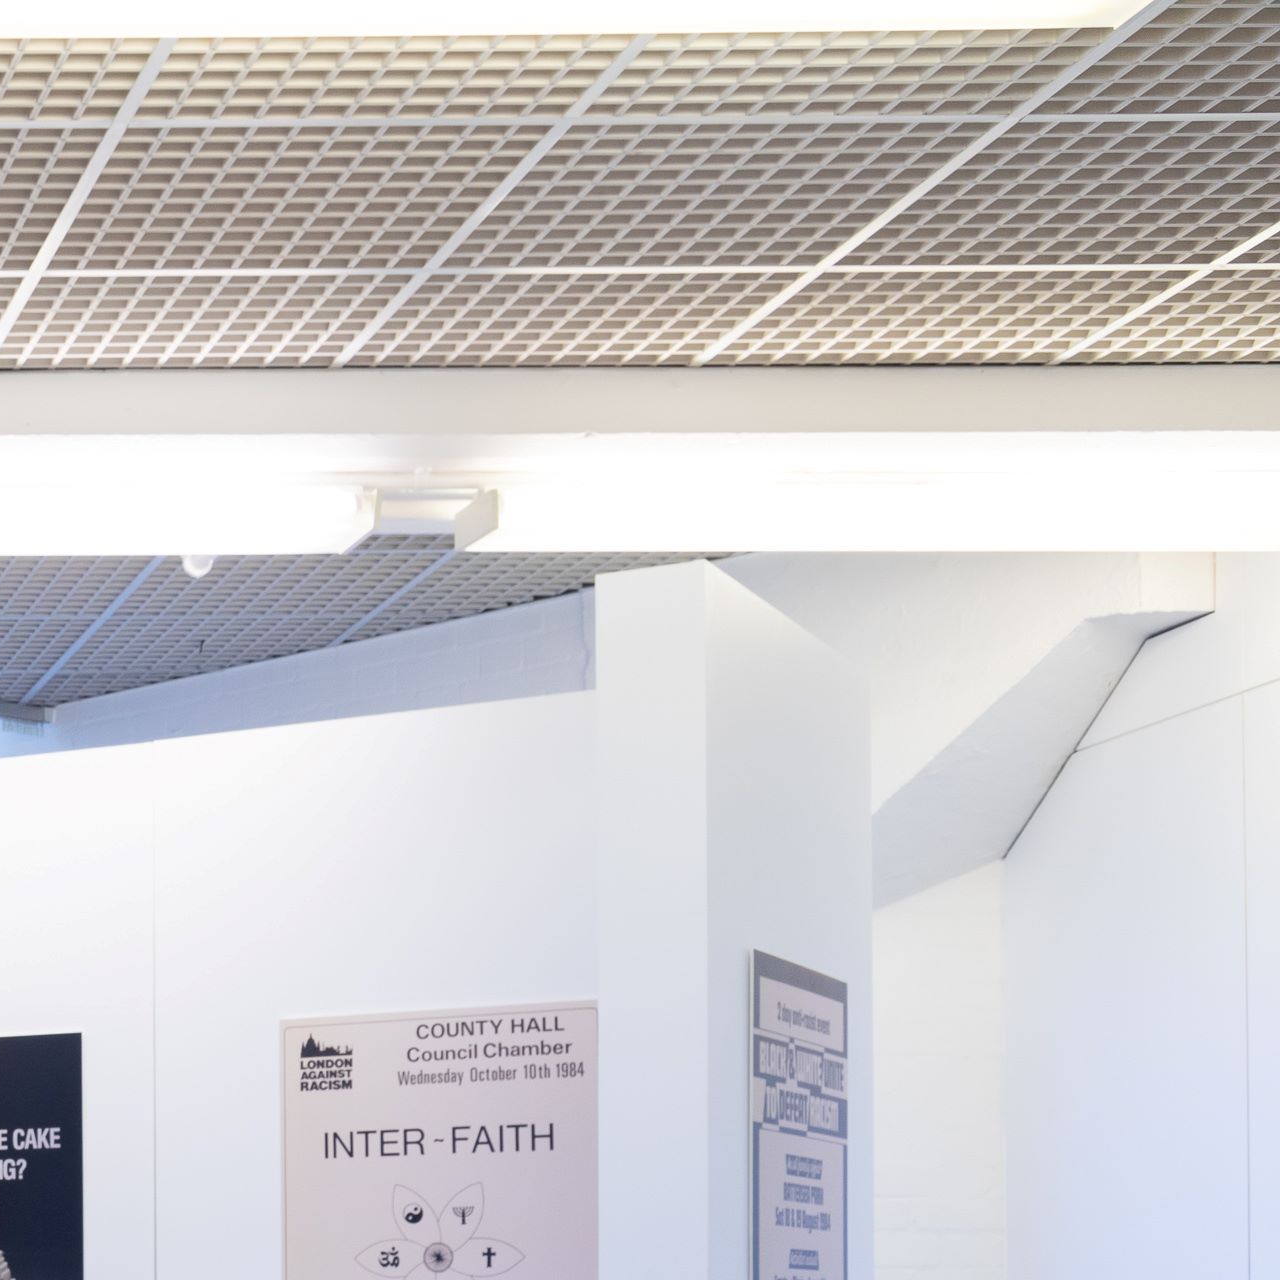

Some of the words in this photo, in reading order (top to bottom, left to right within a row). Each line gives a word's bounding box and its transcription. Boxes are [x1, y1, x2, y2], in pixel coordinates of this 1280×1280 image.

[415, 1019, 503, 1040] COUNTY
[510, 1016, 565, 1034] HALL
[406, 1043, 478, 1063] Council
[483, 1041, 573, 1060] Chamber
[300, 1058, 352, 1070] LONDON
[300, 1069, 352, 1080] AGAINST
[397, 1067, 464, 1087] Wednesday
[470, 1064, 517, 1083] October
[523, 1063, 551, 1081] 10th
[556, 1062, 585, 1078] 1984
[300, 1079, 352, 1092] RACISM
[13, 1127, 61, 1150] CAKE
